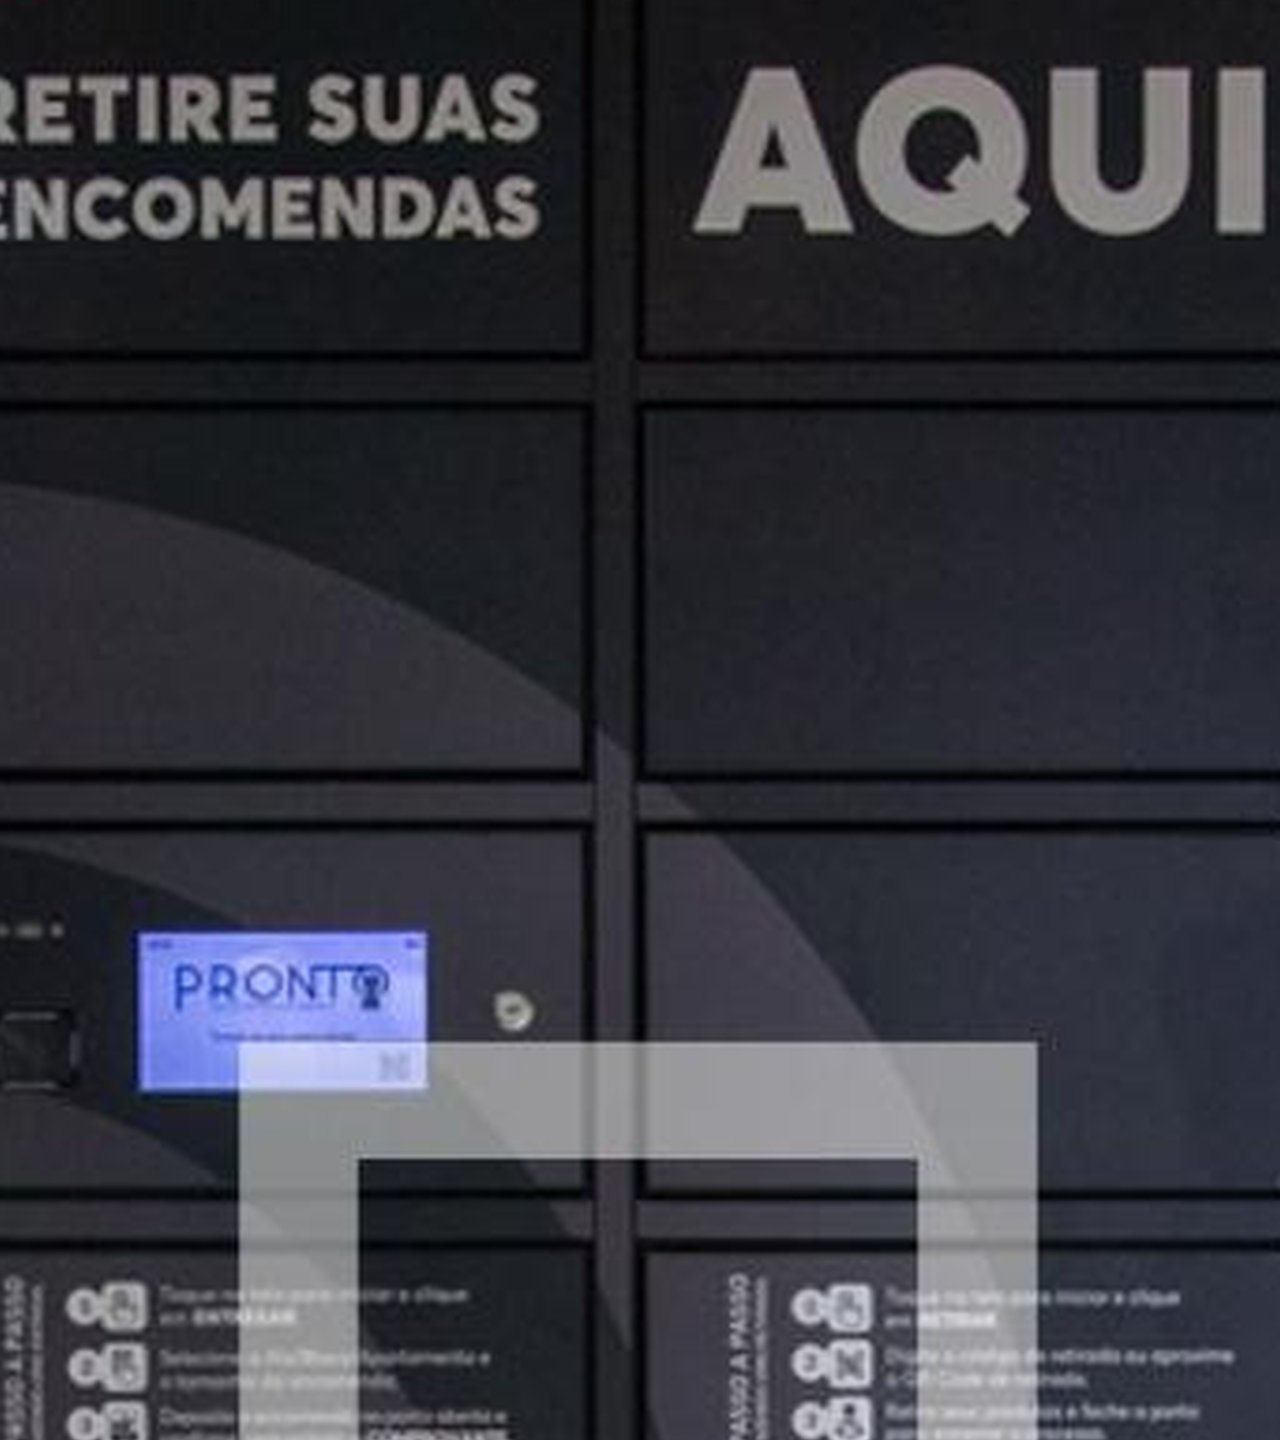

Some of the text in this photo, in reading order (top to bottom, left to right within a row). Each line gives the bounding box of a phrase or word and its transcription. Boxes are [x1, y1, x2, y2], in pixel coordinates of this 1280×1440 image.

[308, 74, 540, 144] SUAS
[693, 65, 1266, 238] AQUI
[173, 962, 390, 1014] PRONTO
